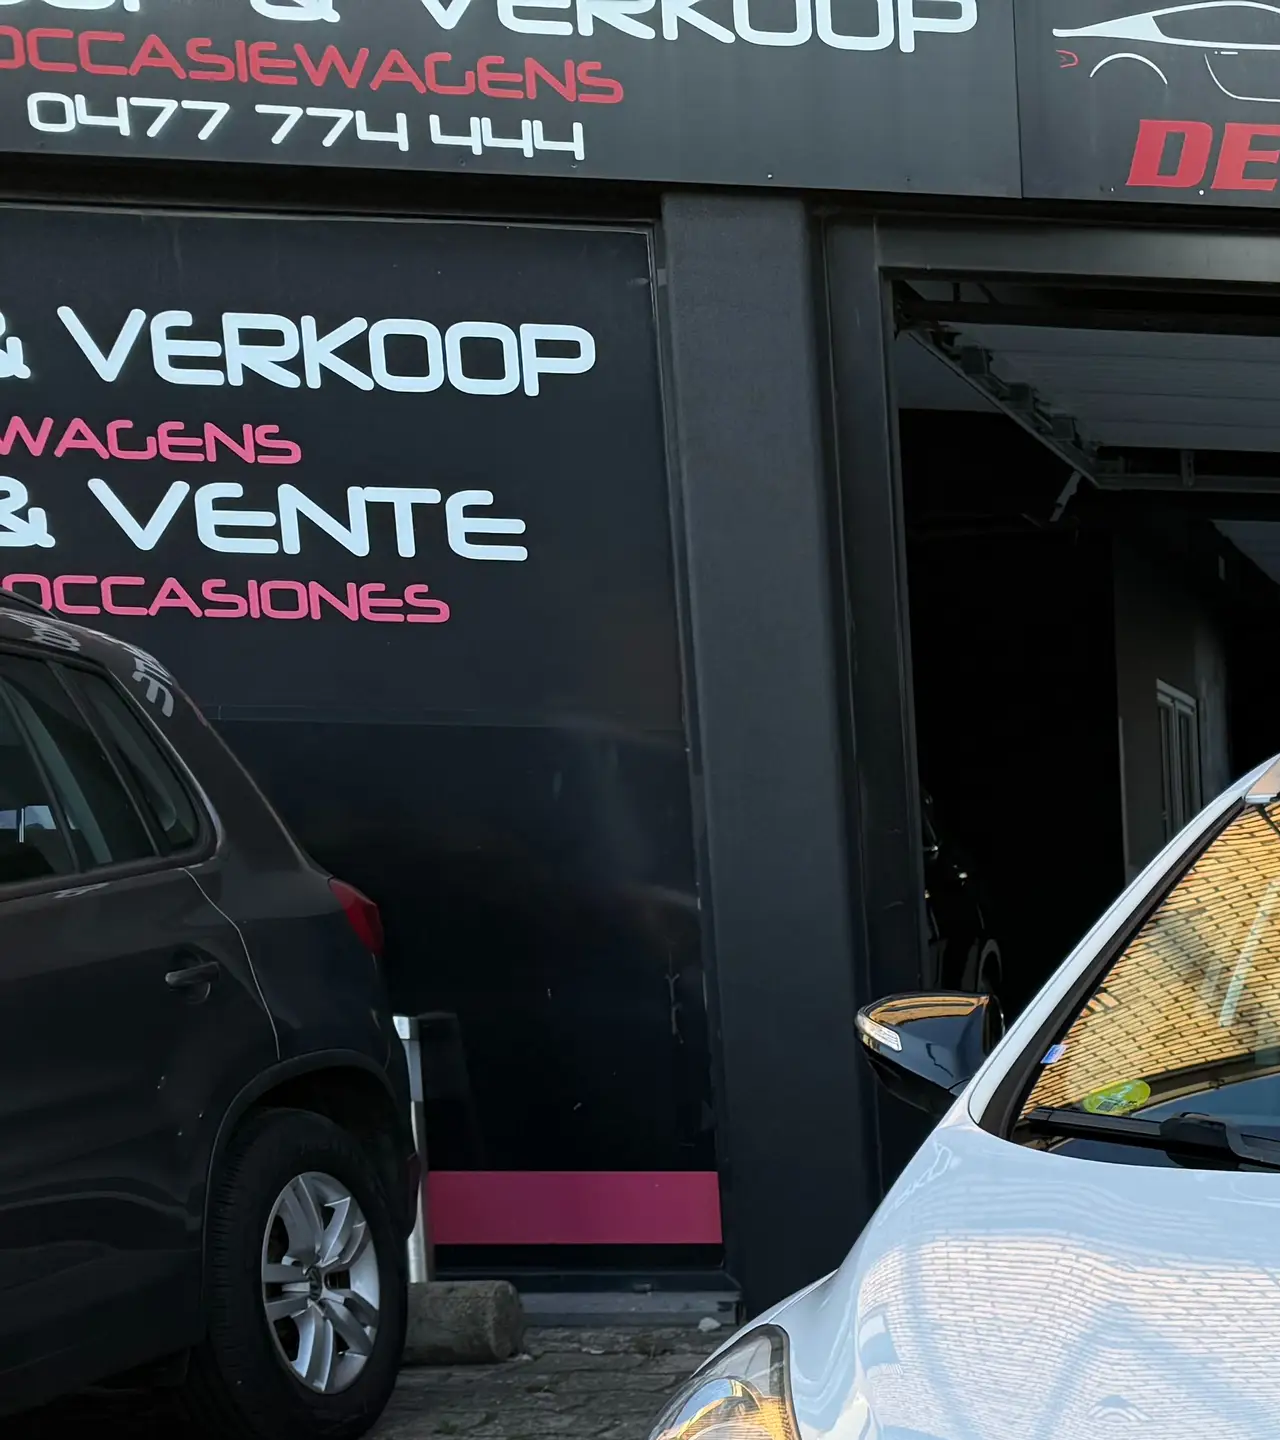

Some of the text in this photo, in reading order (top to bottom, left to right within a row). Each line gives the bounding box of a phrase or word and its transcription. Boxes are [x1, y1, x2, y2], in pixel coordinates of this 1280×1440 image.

[27, 92, 585, 161] 0477 774 444
[57, 305, 596, 397] VERKOOP
[88, 478, 528, 562] VENTE
